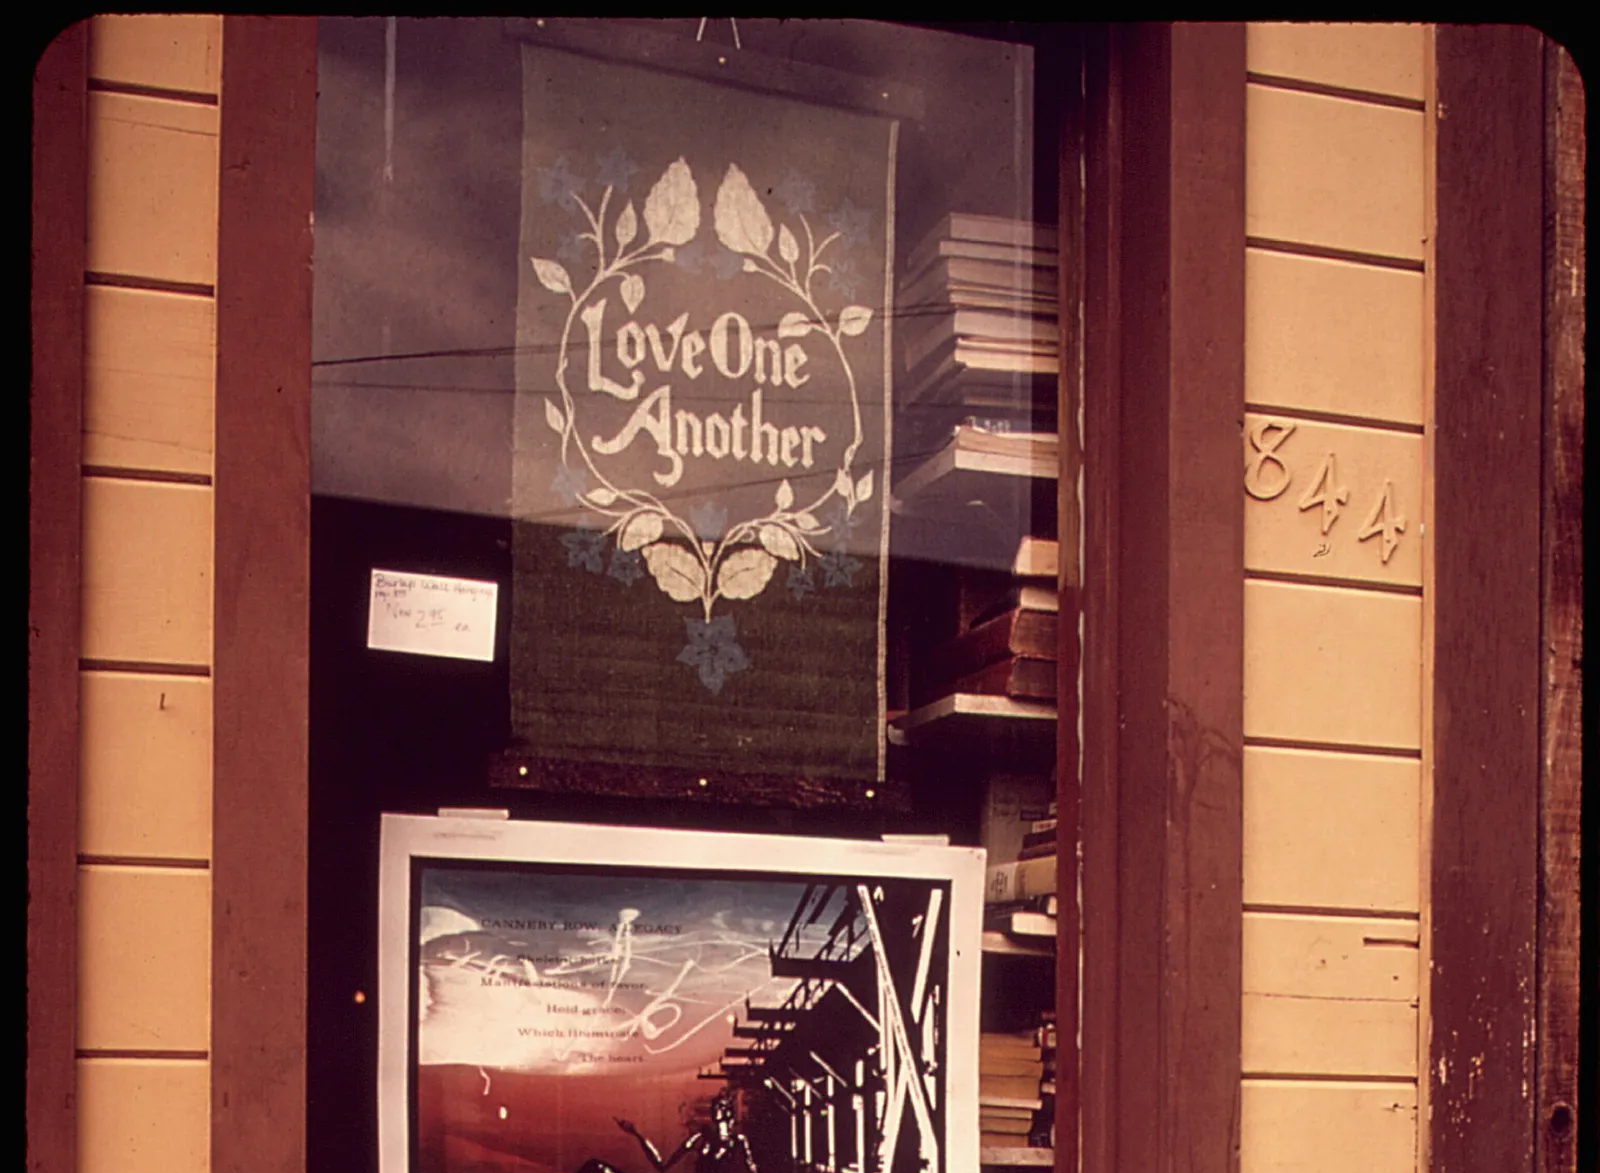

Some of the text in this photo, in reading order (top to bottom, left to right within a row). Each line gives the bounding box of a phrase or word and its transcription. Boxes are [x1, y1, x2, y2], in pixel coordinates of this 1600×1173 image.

[580, 298, 810, 400] Love One
[591, 385, 827, 487] Another
[1243, 422, 1407, 565] 844
[480, 918, 556, 931] CANNERY
[517, 1027, 564, 1039] Which
[578, 1051, 605, 1063] The
